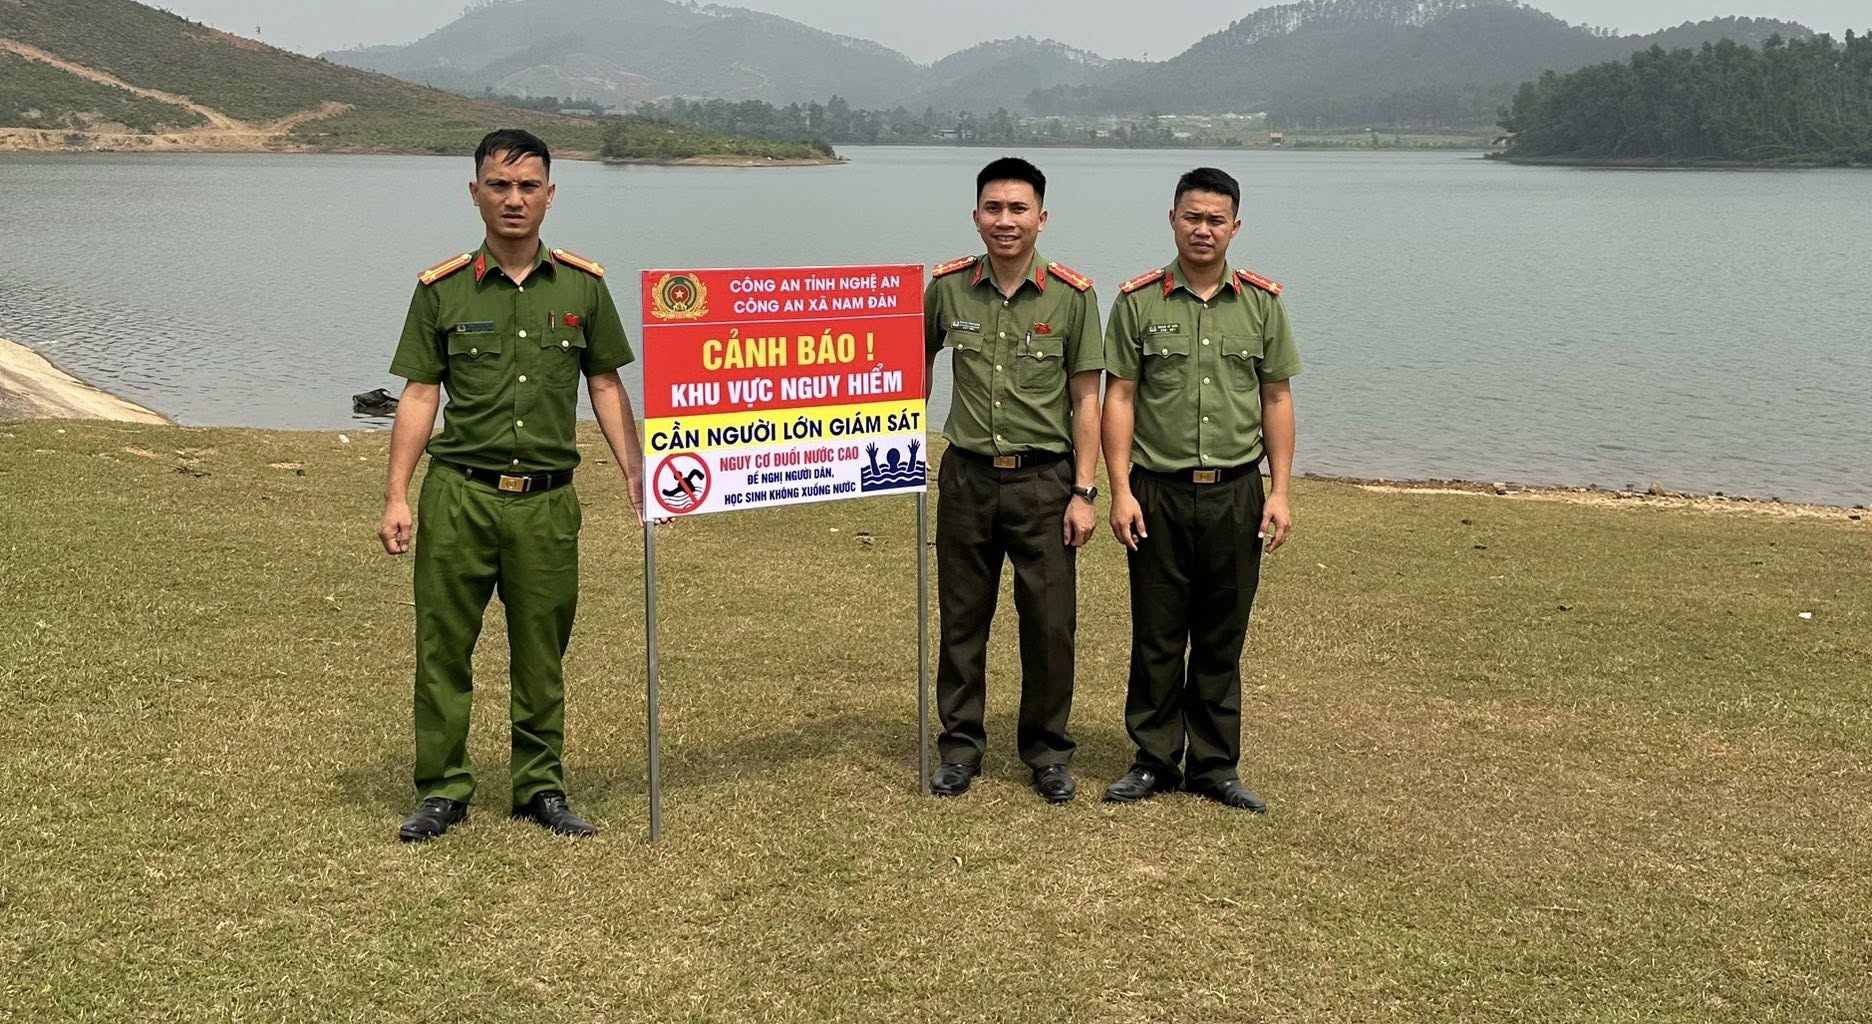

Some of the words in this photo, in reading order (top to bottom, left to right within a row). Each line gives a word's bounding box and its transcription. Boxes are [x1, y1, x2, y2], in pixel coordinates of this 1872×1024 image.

[730, 276, 775, 293] CÔNG
[780, 278, 800, 291] AN
[804, 274, 835, 291] TỈNH
[839, 273, 877, 292] NGHỆ
[881, 275, 900, 288] AN
[734, 297, 779, 313] CÔNG
[784, 299, 803, 312] AN
[808, 296, 828, 311] XÃ
[832, 297, 864, 310] NAM
[867, 293, 897, 308] ĐÀN
[703, 328, 787, 370] CẢNH
[797, 328, 855, 365] BÁO
[866, 332, 874, 361] !
[671, 381, 720, 407] KHU
[727, 377, 773, 407] VỰC
[781, 375, 841, 400] NGUY
[848, 363, 902, 395] HIỂM
[651, 421, 699, 450] CẦN
[708, 419, 776, 446] NGƯỜI
[784, 416, 822, 440] LỚN
[829, 412, 881, 433] GIÁM
[887, 408, 920, 430] SÁT
[720, 455, 751, 472] NGUY
[755, 452, 770, 468] CƠ
[774, 447, 800, 466] ĐUỐI
[804, 446, 834, 464] NƯỚC
[838, 446, 859, 461] CAO
[762, 472, 783, 484] NGHỊ
[785, 467, 811, 481] NGƯỜI
[724, 494, 743, 506] HỌC
[745, 491, 767, 503] SINH
[769, 487, 799, 500] KHÔNG
[802, 483, 830, 497] XUỐNG
[833, 481, 856, 494] NƯỚC
